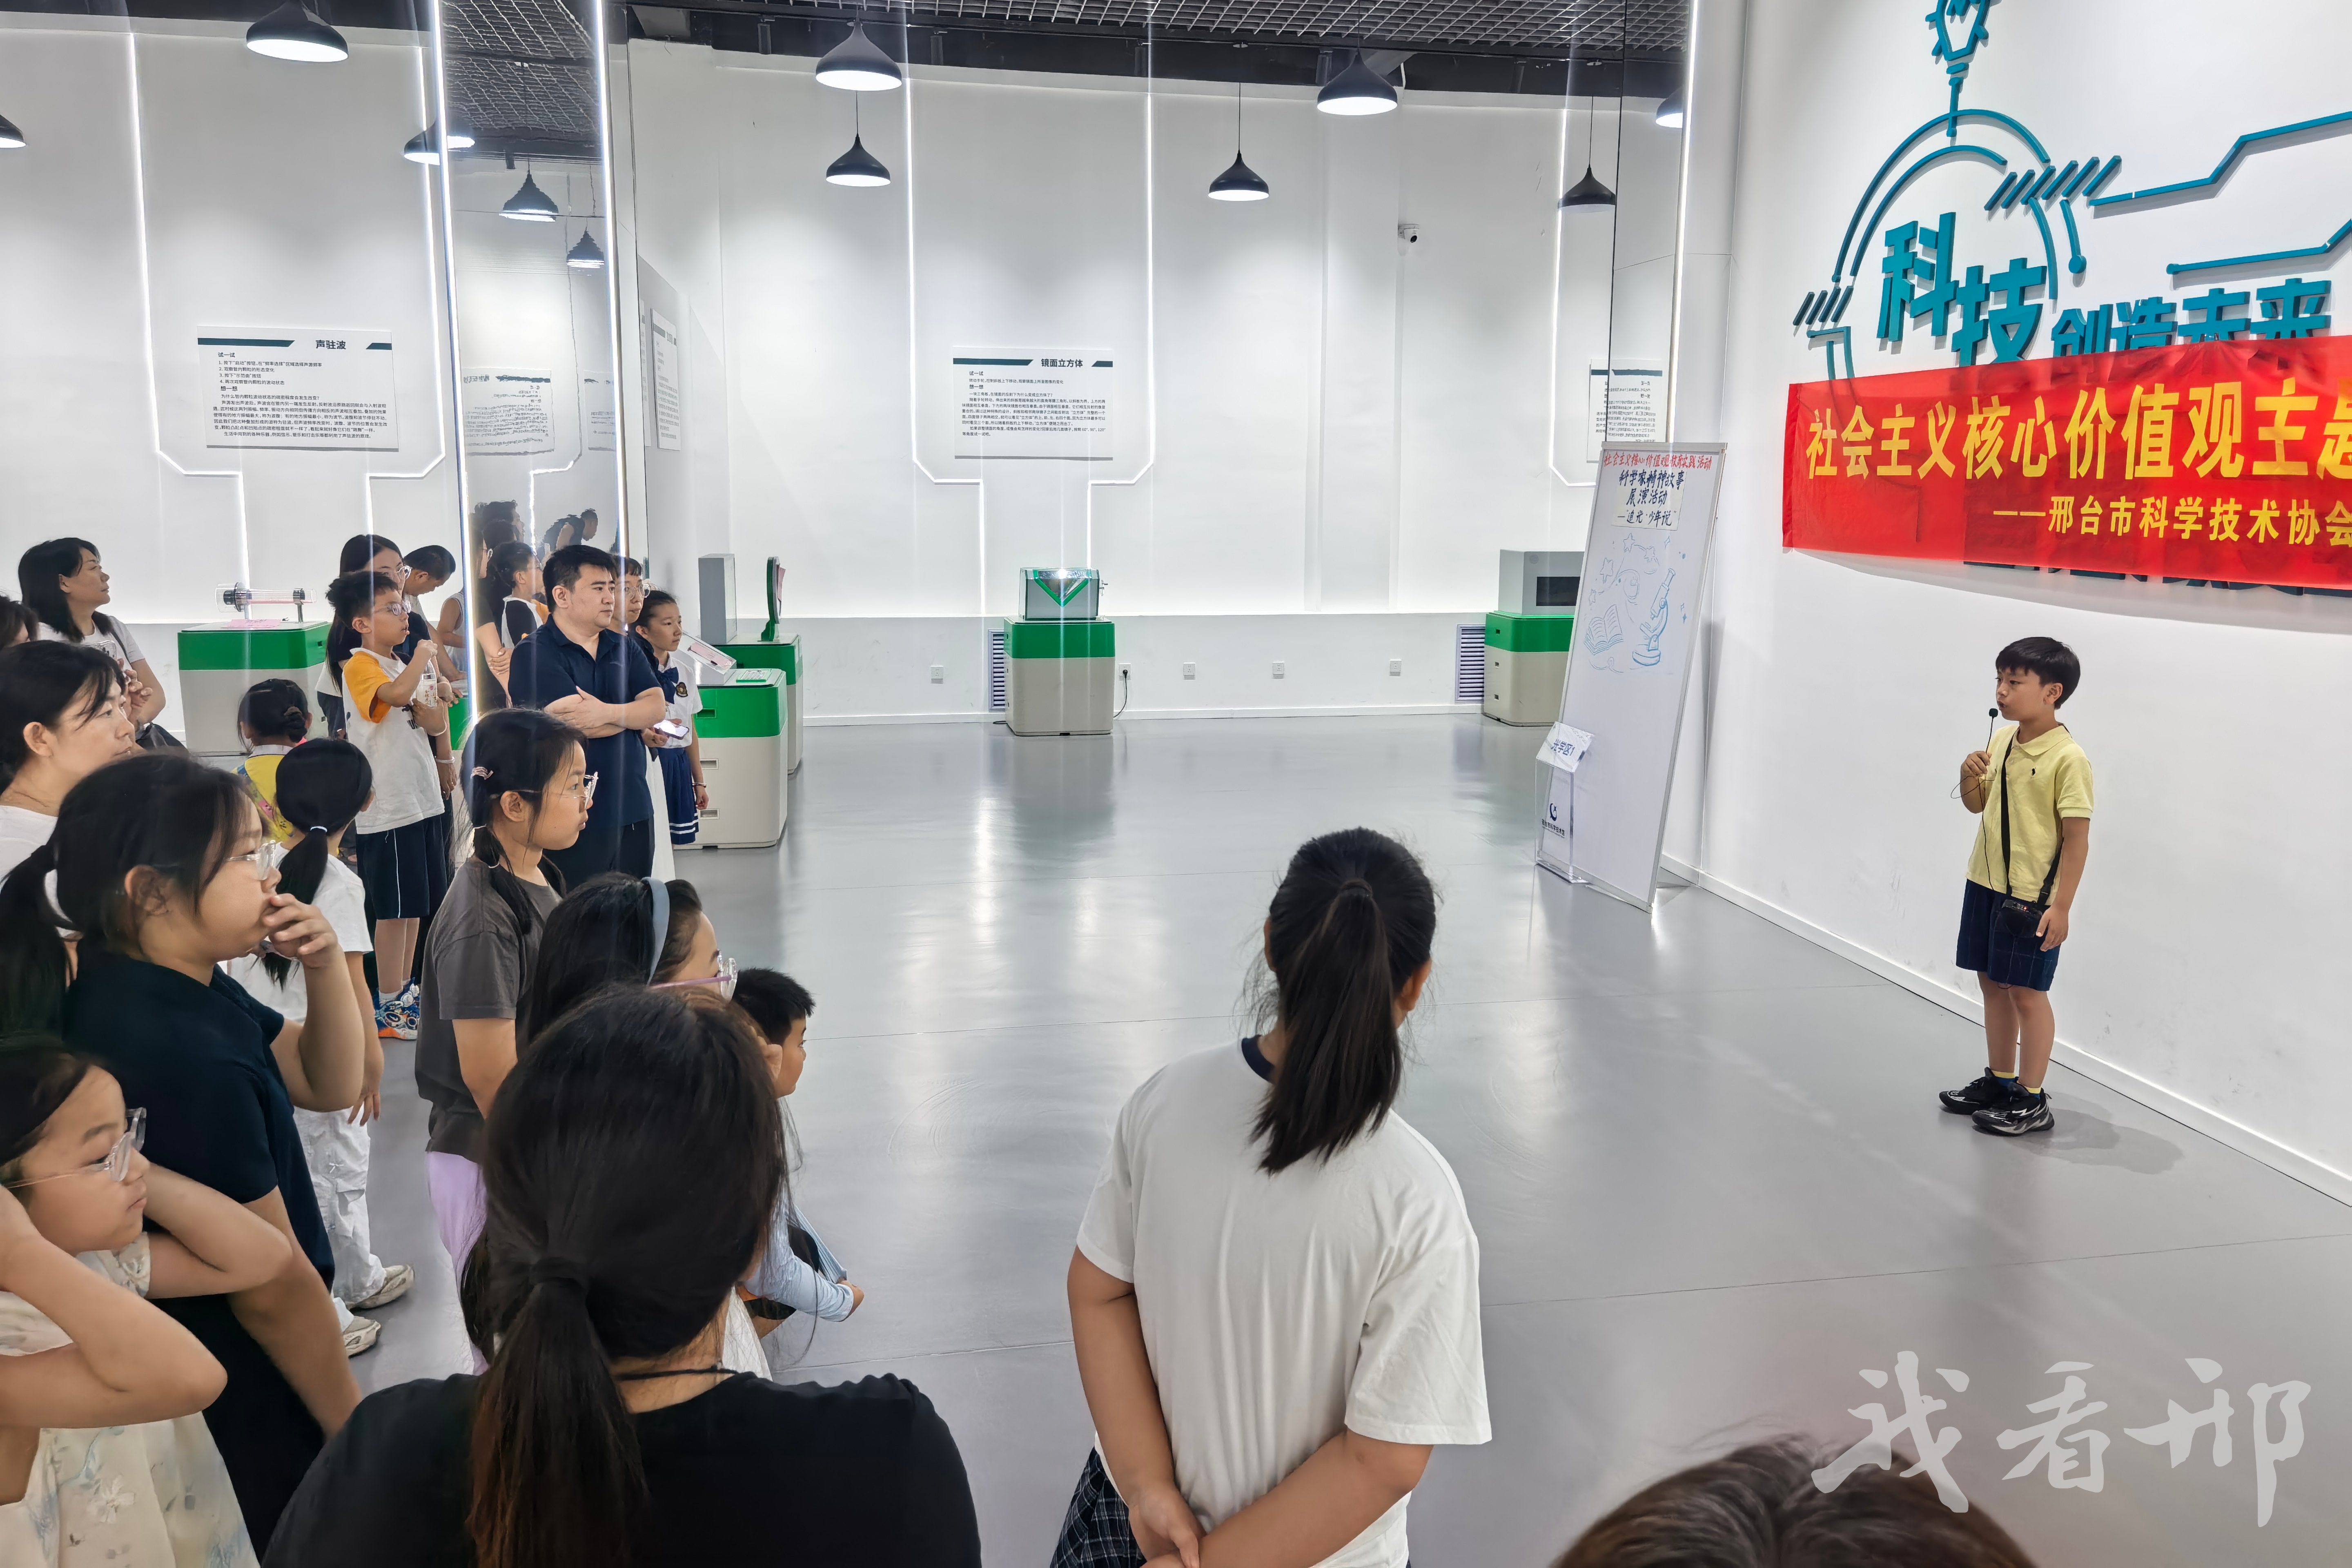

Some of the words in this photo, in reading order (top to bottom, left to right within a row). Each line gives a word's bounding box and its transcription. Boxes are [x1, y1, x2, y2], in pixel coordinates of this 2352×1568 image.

[1877, 212, 2047, 365] 科技
[2051, 278, 2331, 358] 创造未来
[315, 340, 347, 350] 声驻波
[1041, 358, 1083, 368] 镜面立方体
[1619, 469, 1684, 490] 科学家精神故事
[1626, 488, 1668, 508] 展演活动
